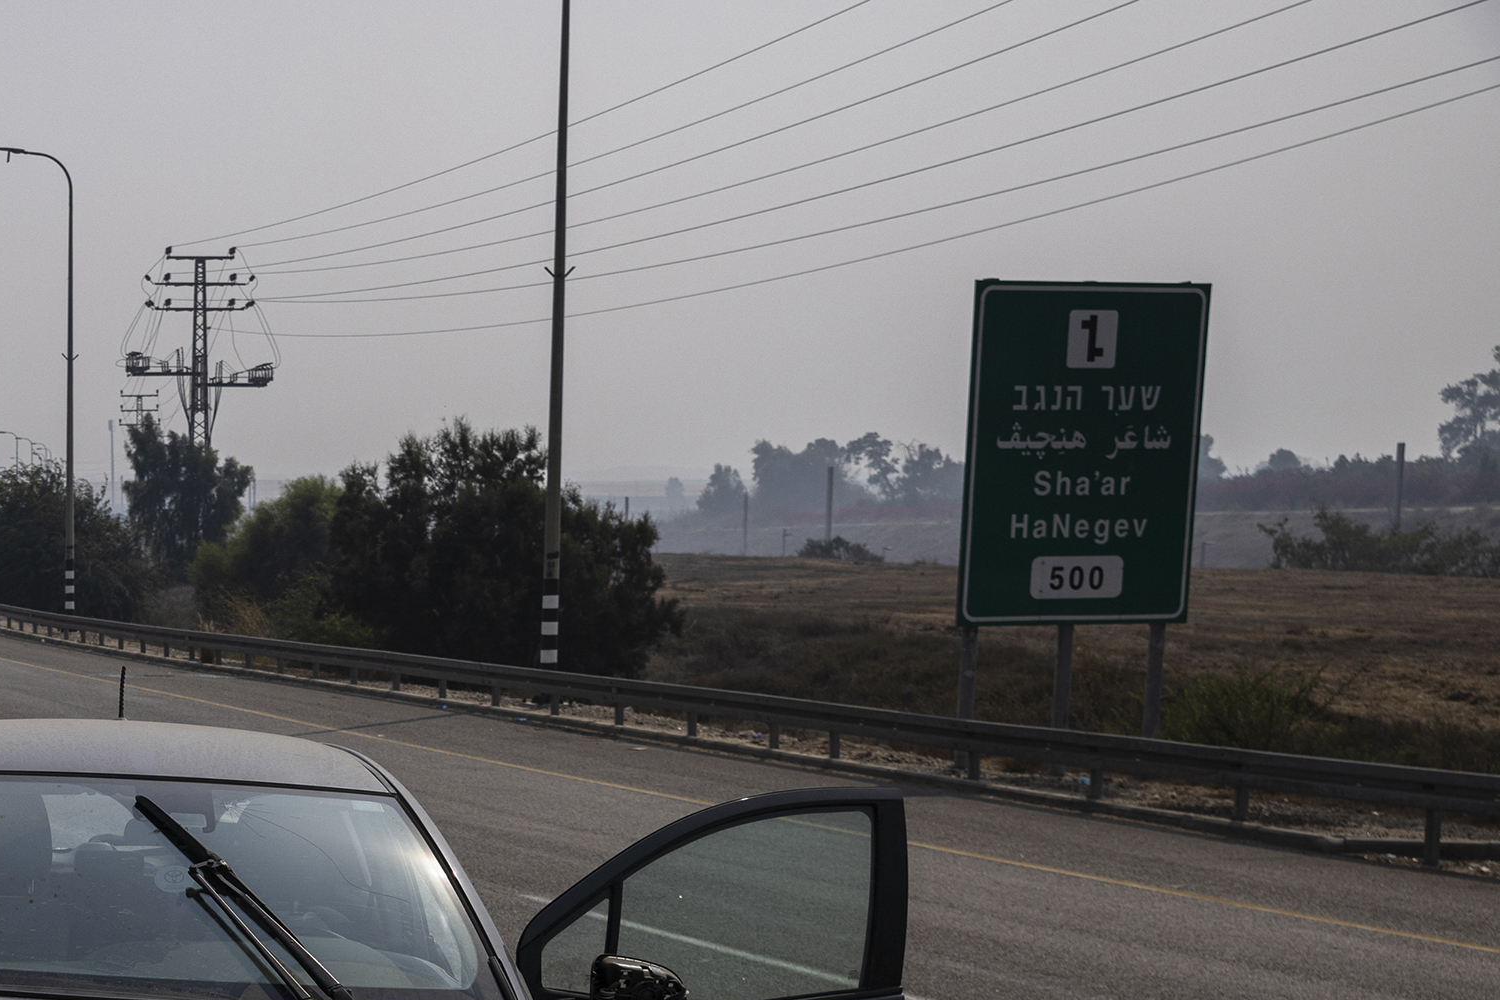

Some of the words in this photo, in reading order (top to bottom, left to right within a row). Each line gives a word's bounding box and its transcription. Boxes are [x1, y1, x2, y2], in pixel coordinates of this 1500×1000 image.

[1012, 385, 1082, 410] הנגב
[1101, 385, 1161, 410] שער
[1033, 470, 1130, 496] Sha'ar
[1010, 514, 1148, 545] HaNegev
[1049, 566, 1103, 590] 500
